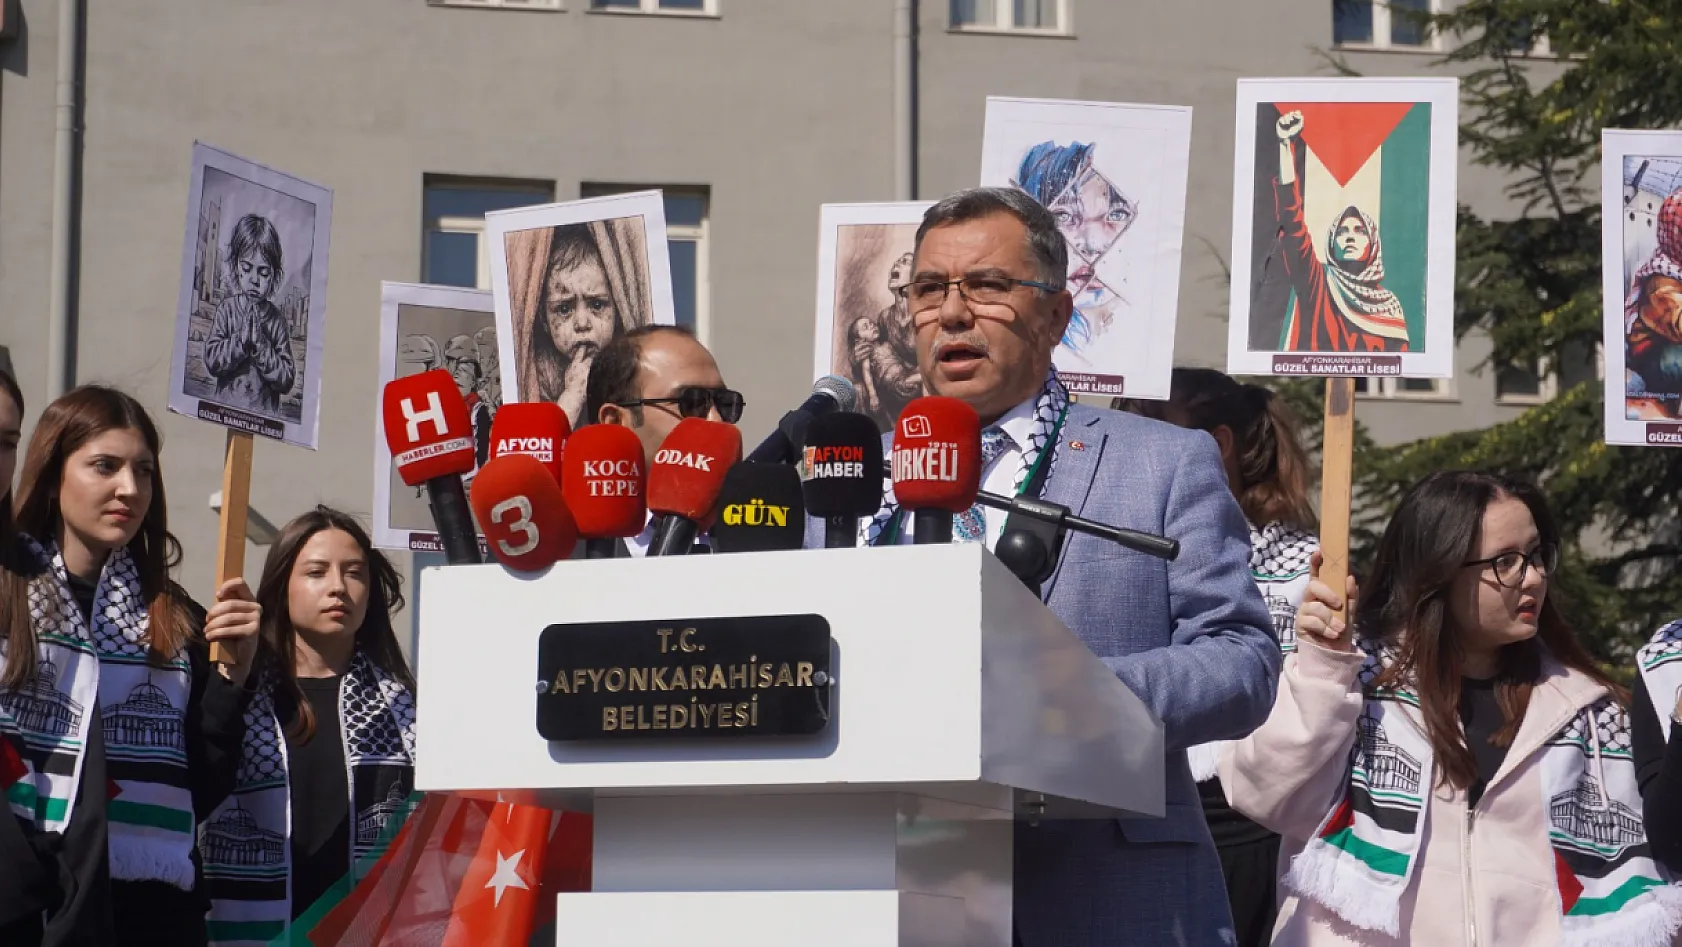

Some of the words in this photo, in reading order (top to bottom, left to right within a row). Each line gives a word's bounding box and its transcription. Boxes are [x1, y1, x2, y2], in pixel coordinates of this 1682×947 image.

[1274, 363, 1309, 373] GÜZEL
[1311, 364, 1365, 374] SANATLAR
[1366, 363, 1400, 374] LİSESİ
[1091, 382, 1122, 393] LİSESİ
[199, 409, 221, 422] GÜZEL
[223, 416, 260, 432] SANATLAR
[400, 391, 449, 442] H
[401, 440, 466, 461] HABERLER.COM
[496, 438, 553, 452] AFYON
[814, 446, 864, 462] AFYON
[583, 459, 640, 477] KOCA
[654, 449, 715, 472] ODAK
[814, 461, 864, 478] HABER
[892, 442, 958, 483] ÜRKELİ
[586, 480, 639, 497] TEPE
[723, 498, 790, 527] GÜN
[491, 495, 539, 556] 3
[411, 540, 439, 550] GÜZEL
[656, 627, 706, 654] T.C.
[551, 654, 814, 695] AFYONKARAHİSAR
[602, 694, 759, 731] BELEDİYESİ
